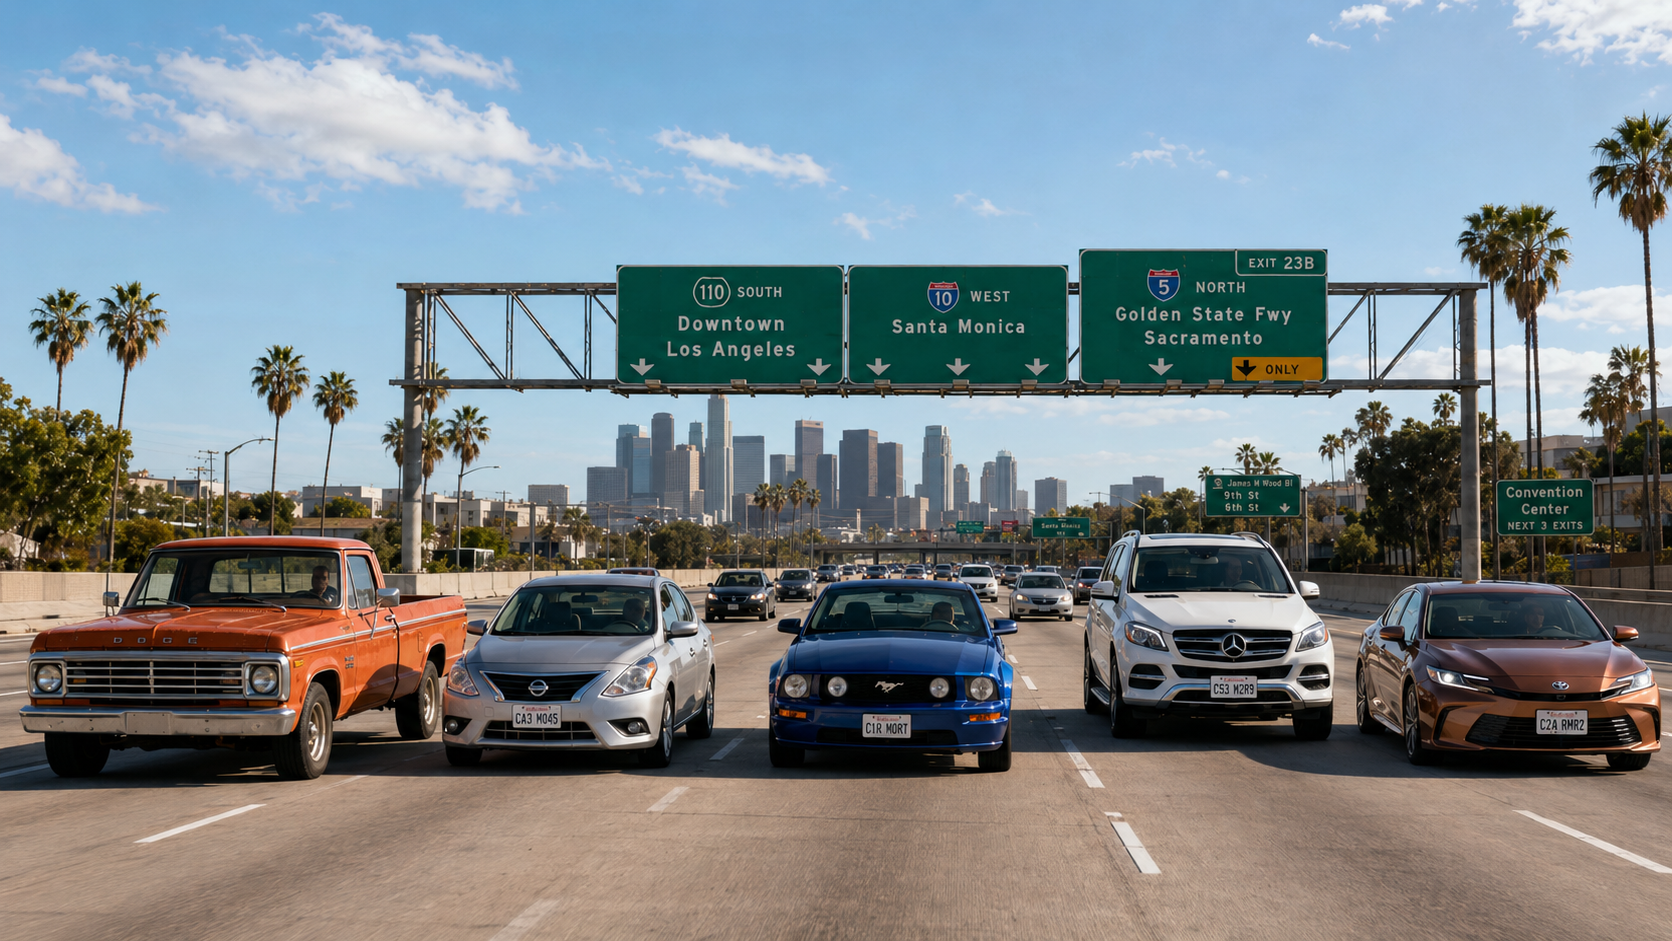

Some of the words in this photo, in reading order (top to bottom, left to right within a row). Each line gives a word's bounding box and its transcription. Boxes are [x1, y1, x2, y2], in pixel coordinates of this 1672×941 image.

[1248, 258, 1276, 268] EXIT
[1283, 256, 1315, 270] 23B
[699, 284, 725, 301] 110
[737, 286, 783, 299] SOUTH
[1158, 279, 1170, 295] 5
[1196, 281, 1246, 293] NORTH
[935, 291, 952, 308] 10
[970, 290, 1010, 302] WEST
[1115, 306, 1182, 322] Golden
[1192, 306, 1244, 322] State
[1255, 306, 1292, 325] Fwy
[678, 315, 785, 332] Downtown
[892, 319, 947, 334] Santa
[958, 319, 1025, 334] Monica
[1144, 330, 1263, 345] Sacramento
[667, 341, 702, 357] Los
[712, 341, 796, 361] Angeles
[1265, 364, 1299, 375] ONLY
[1224, 491, 1242, 500] 9th
[1248, 491, 1259, 500] St
[1506, 486, 1583, 498] Convention
[1248, 503, 1259, 512] St
[1521, 503, 1569, 515] Center
[1507, 521, 1535, 530] NEXT
[1541, 521, 1547, 530] 3
[1553, 521, 1583, 530] EXITS
[515, 712, 532, 725] CA3
[1540, 718, 1558, 731] C2A
